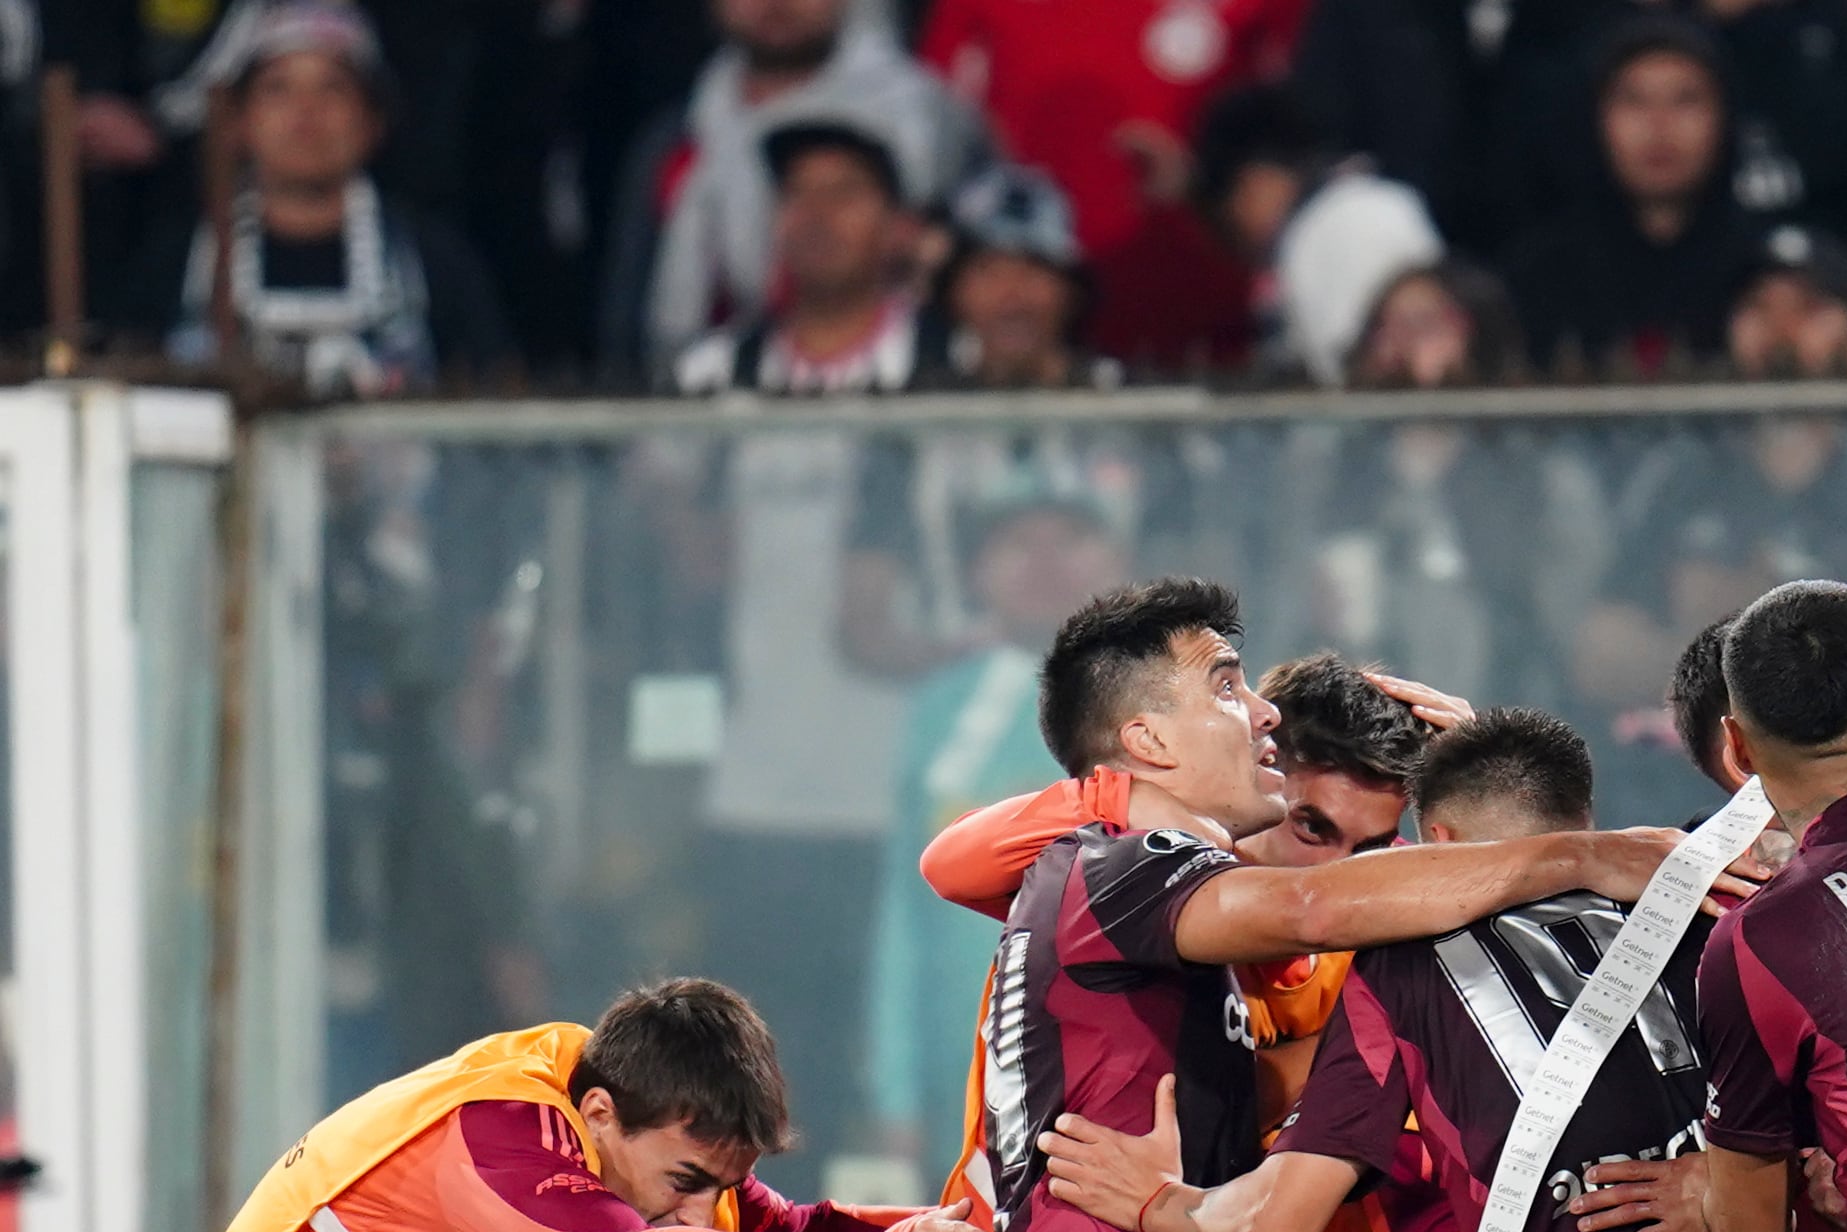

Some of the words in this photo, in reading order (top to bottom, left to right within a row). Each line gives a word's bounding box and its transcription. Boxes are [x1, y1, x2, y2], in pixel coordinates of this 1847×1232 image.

[1661, 871, 1695, 892] Getnet
[1641, 905, 1675, 927] Getnet
[1621, 938, 1655, 961] Getnet
[1601, 970, 1635, 993] Getnet
[1580, 1002, 1614, 1025] Getnet
[1561, 1033, 1594, 1054] Getnet
[1542, 1069, 1575, 1089] Getnet
